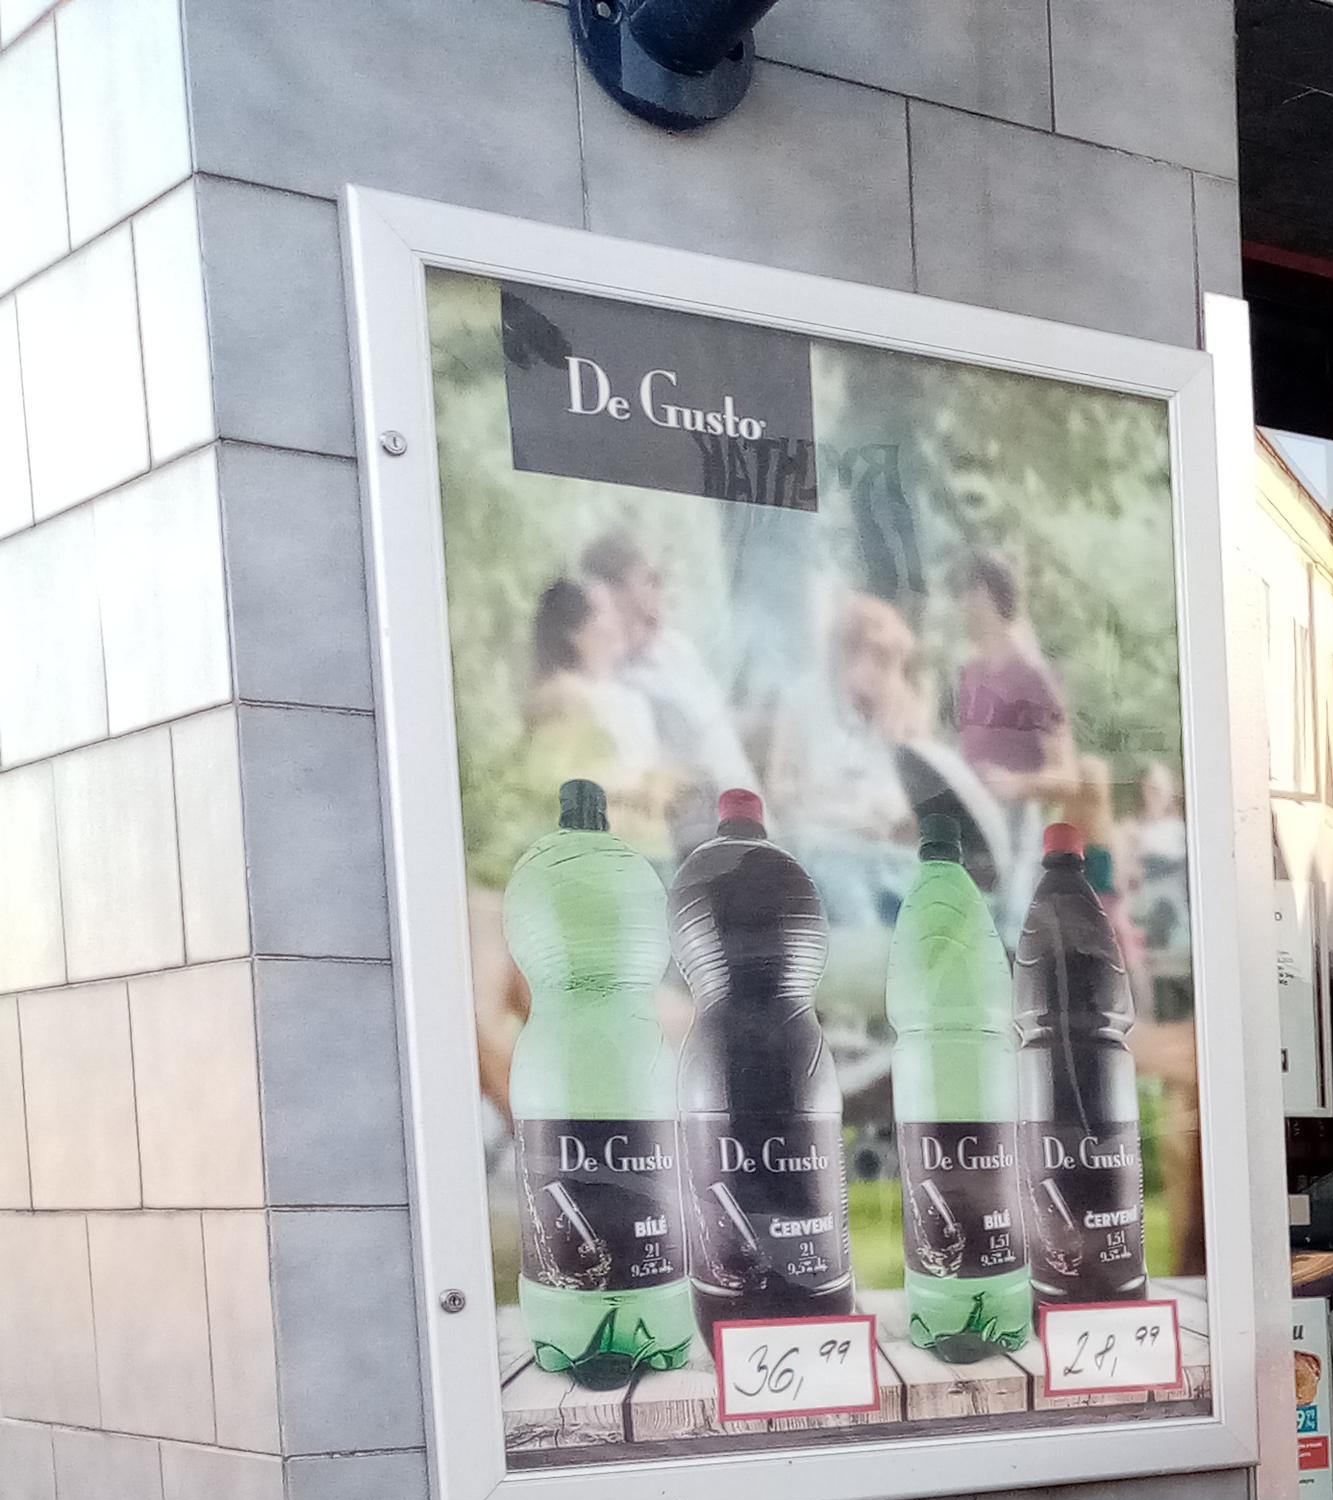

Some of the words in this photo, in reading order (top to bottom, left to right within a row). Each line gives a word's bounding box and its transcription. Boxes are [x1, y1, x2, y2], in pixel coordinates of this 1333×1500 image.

[564, 355, 632, 421] De
[640, 369, 762, 441] Gusto
[558, 1135, 599, 1172] De
[604, 1135, 673, 1172] Gusto
[718, 1136, 757, 1173] De
[762, 1136, 829, 1173] Gusto
[921, 1136, 953, 1170] De
[957, 1135, 1014, 1170] Gusto
[1042, 1136, 1076, 1170] De
[1079, 1136, 1135, 1170] Gusto
[634, 1214, 668, 1239] BÍLÉ
[768, 1212, 835, 1239] ČERVENÉ
[983, 1208, 1012, 1231] BÍLÉ
